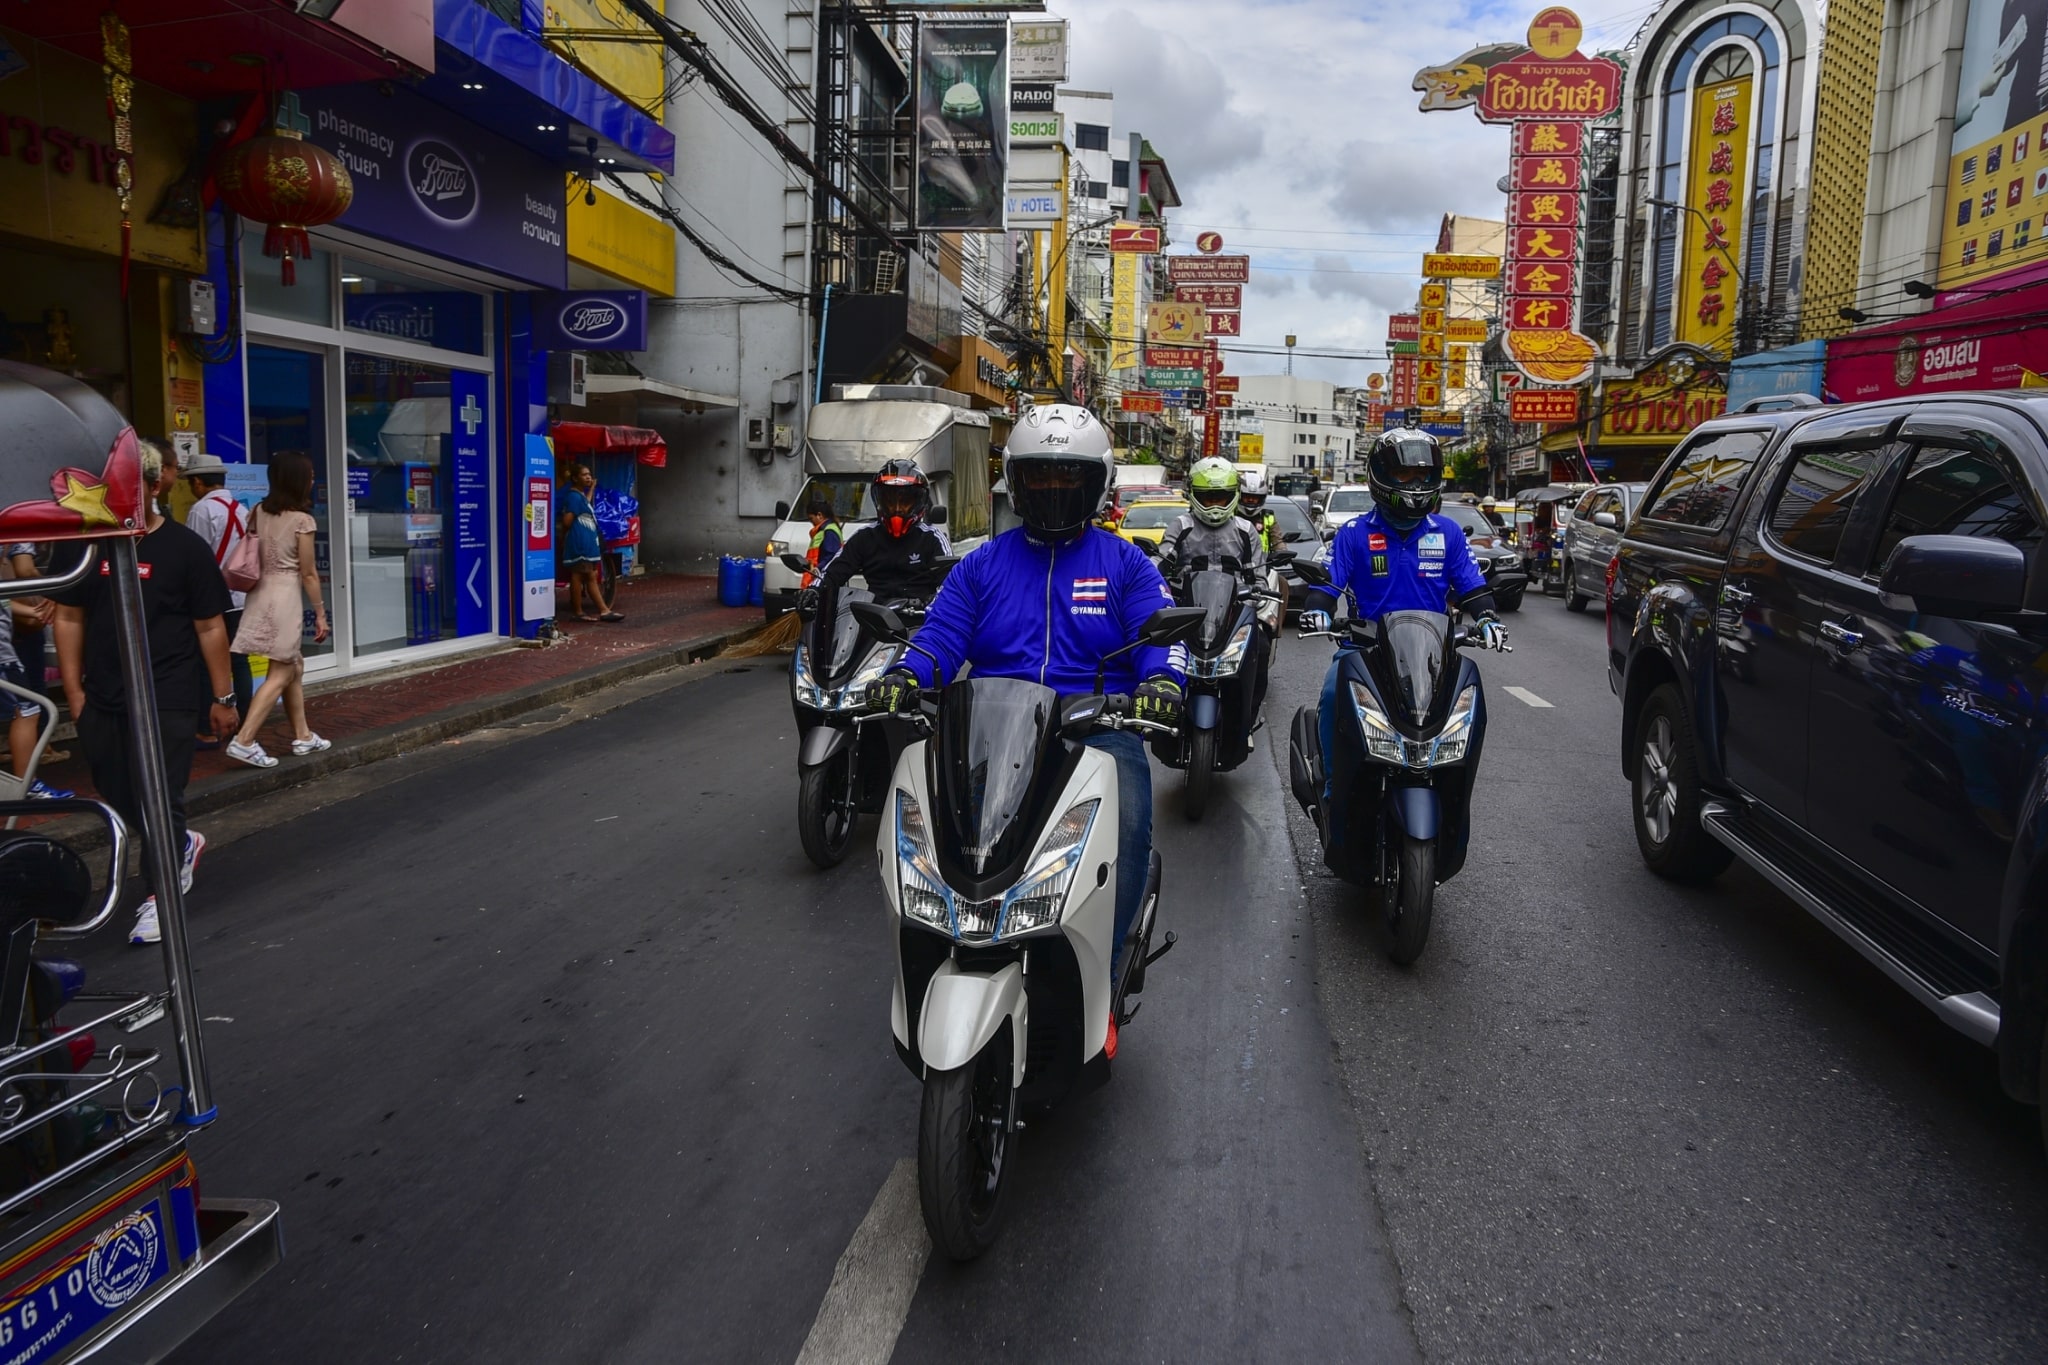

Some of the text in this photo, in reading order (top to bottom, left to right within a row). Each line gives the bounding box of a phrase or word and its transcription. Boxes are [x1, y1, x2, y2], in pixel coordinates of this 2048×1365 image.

[1012, 90, 1053, 101] RADO
[318, 109, 395, 157] pharmacy
[336, 142, 381, 180] ร้านยา
[417, 153, 467, 201] Boots
[525, 194, 557, 221] beauty
[1021, 198, 1056, 213] HOTEL
[1697, 102, 1738, 325] 蘇成興大金行
[522, 222, 561, 247] ความงาม
[1522, 124, 1567, 326] 蘇成興大金行
[1174, 271, 1196, 279] CHINA
[569, 308, 615, 333] Boots
[1421, 289, 1441, 401] 汕頭長春酒
[1151, 352, 1180, 361] หูฉลาม
[1150, 370, 1175, 379] รังนก
[1410, 359, 1418, 404] HOTEL
[1775, 371, 1798, 390] ATM
[1385, 418, 1404, 428] ROO
[1040, 433, 1069, 444] Arai
[1079, 606, 1107, 615] YAMAHA
[960, 846, 993, 857] YAMAHA
